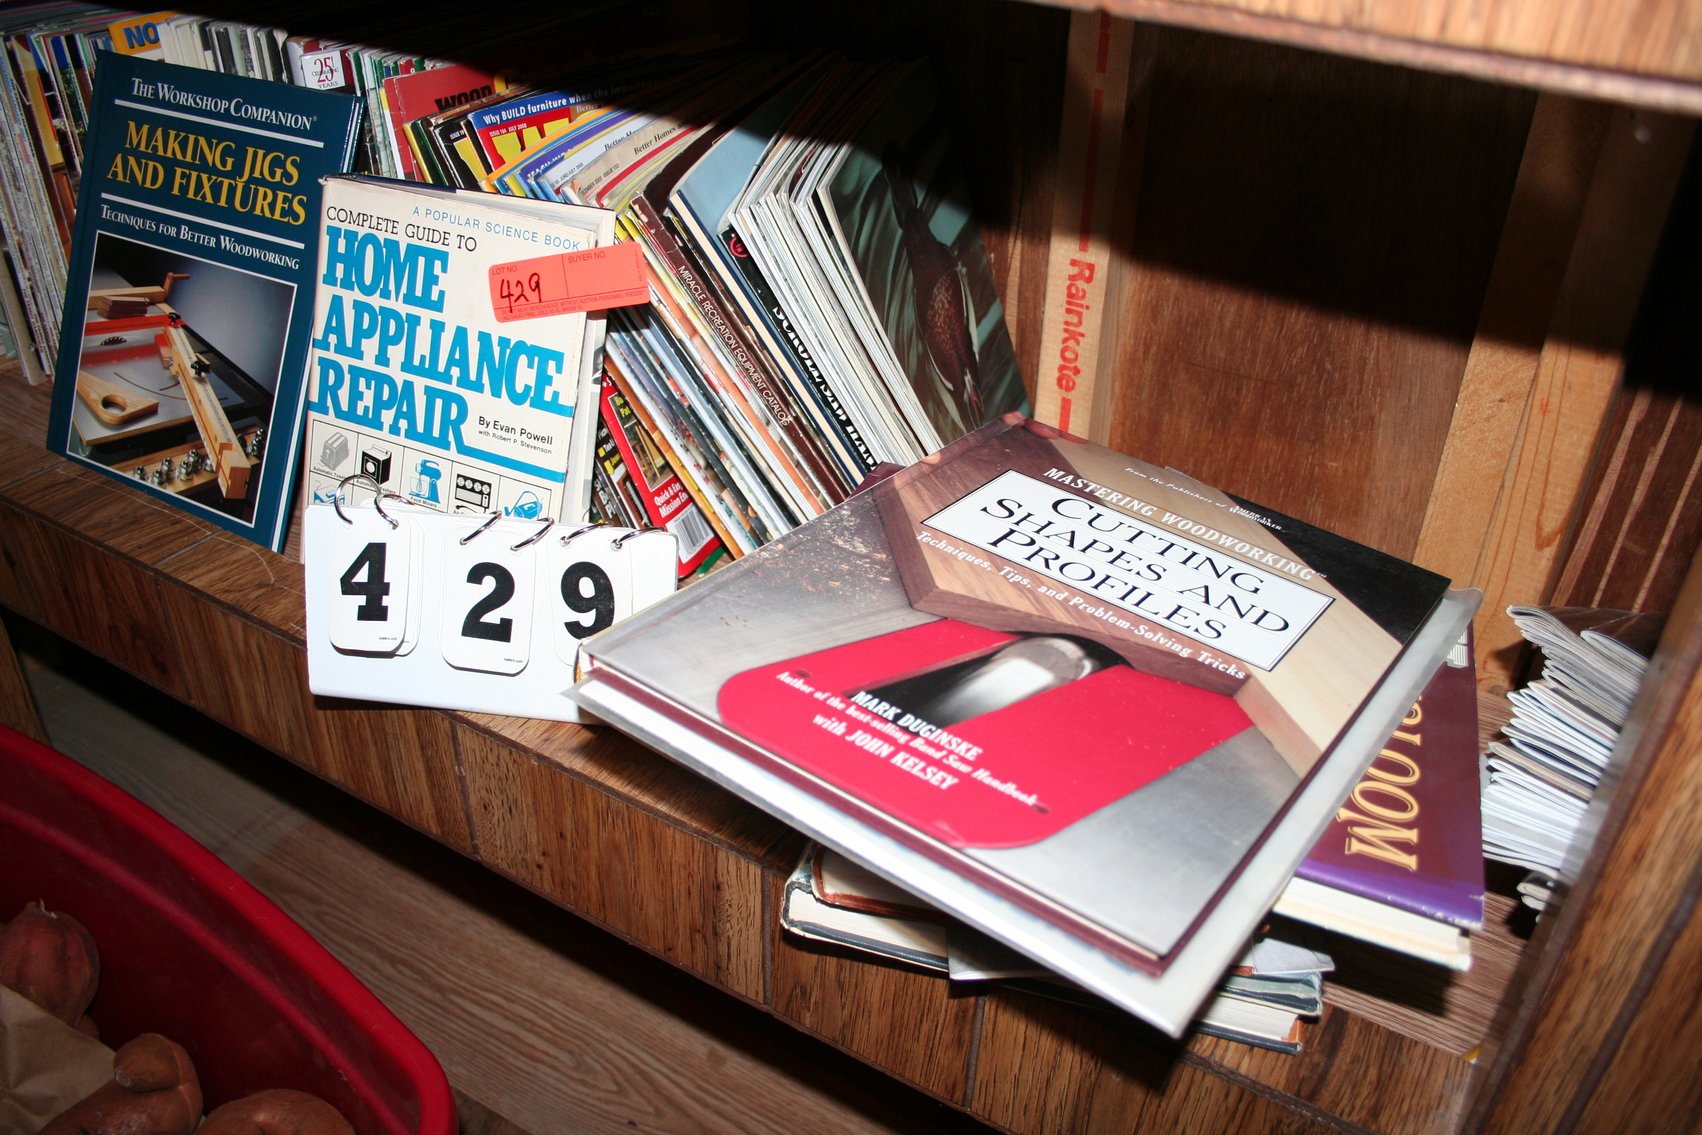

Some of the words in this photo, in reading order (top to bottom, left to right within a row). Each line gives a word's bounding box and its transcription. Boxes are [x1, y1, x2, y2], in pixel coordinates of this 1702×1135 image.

[131, 77, 155, 98] THE
[156, 82, 230, 114] WORKSHOP
[483, 114, 500, 124] Why
[501, 106, 526, 120] BUILD
[528, 97, 568, 115] furniture
[569, 92, 592, 105] when
[125, 121, 236, 171] MAKING
[236, 146, 300, 187] JIGS
[633, 139, 653, 155] Better
[654, 127, 676, 142] Homes
[107, 153, 164, 190] AND
[171, 167, 307, 226] FIXTURES
[101, 204, 156, 232] TECHNIQUES
[159, 224, 177, 237] FOR
[179, 225, 217, 248] BETTER
[220, 235, 300, 270] WOODWORKING
[326, 206, 400, 235] COMPLETE
[404, 225, 450, 247] GUIDE
[456, 235, 478, 252] TO
[413, 206, 420, 216] A
[424, 208, 480, 230] POPULAR
[485, 221, 539, 243] SCIENCE
[544, 234, 581, 252] BOOK
[568, 254, 591, 264] BUYER
[322, 225, 449, 313] HOME
[492, 267, 505, 275] LOT
[500, 272, 542, 313] 429
[313, 294, 574, 417] APPLIANCE
[678, 265, 706, 301] MIRACLE
[703, 300, 738, 350] RECREATION
[734, 347, 766, 390] EQUIPMENT
[762, 388, 791, 426] CATALOG
[1057, 258, 1095, 393] Rainkote
[308, 356, 470, 452] REPAIR
[479, 416, 491, 428] By
[493, 420, 516, 435] Evan
[520, 428, 553, 445] Powell
[492, 433, 511, 443] Robert
[520, 441, 552, 455] Stevenson
[654, 488, 670, 505] Quick
[669, 482, 676, 494] &
[659, 495, 680, 519] Mission
[1124, 467, 1147, 479] From
[1149, 476, 1164, 485] the
[1166, 482, 1213, 504] Publishers
[1043, 468, 1156, 518] MASTERING
[1161, 510, 1317, 582] WOODWORKING
[1051, 497, 1274, 595] CUTTING
[339, 542, 391, 622] 4
[461, 561, 516, 643] 2
[560, 561, 615, 640] 9
[979, 498, 1168, 584] SHAPES
[1186, 583, 1290, 633] AND
[988, 528, 1228, 640] PROFILES
[916, 530, 993, 572] Techniques,
[997, 564, 1033, 590] Tips,
[1037, 583, 1066, 602] and
[1069, 595, 1194, 660] Problem-Solving
[1196, 650, 1247, 681] Tricks
[776, 671, 814, 694] Author
[814, 687, 828, 701] of
[826, 693, 846, 711] the
[846, 703, 909, 745] best-selling
[909, 735, 949, 762] Band
[943, 754, 974, 774] Saw
[973, 766, 1038, 807] Handbook
[813, 713, 845, 737] with
[845, 729, 896, 759] JOHN
[890, 749, 959, 791] KELSEY
[850, 690, 901, 722] MARK
[898, 713, 984, 762] DUGINSKE
